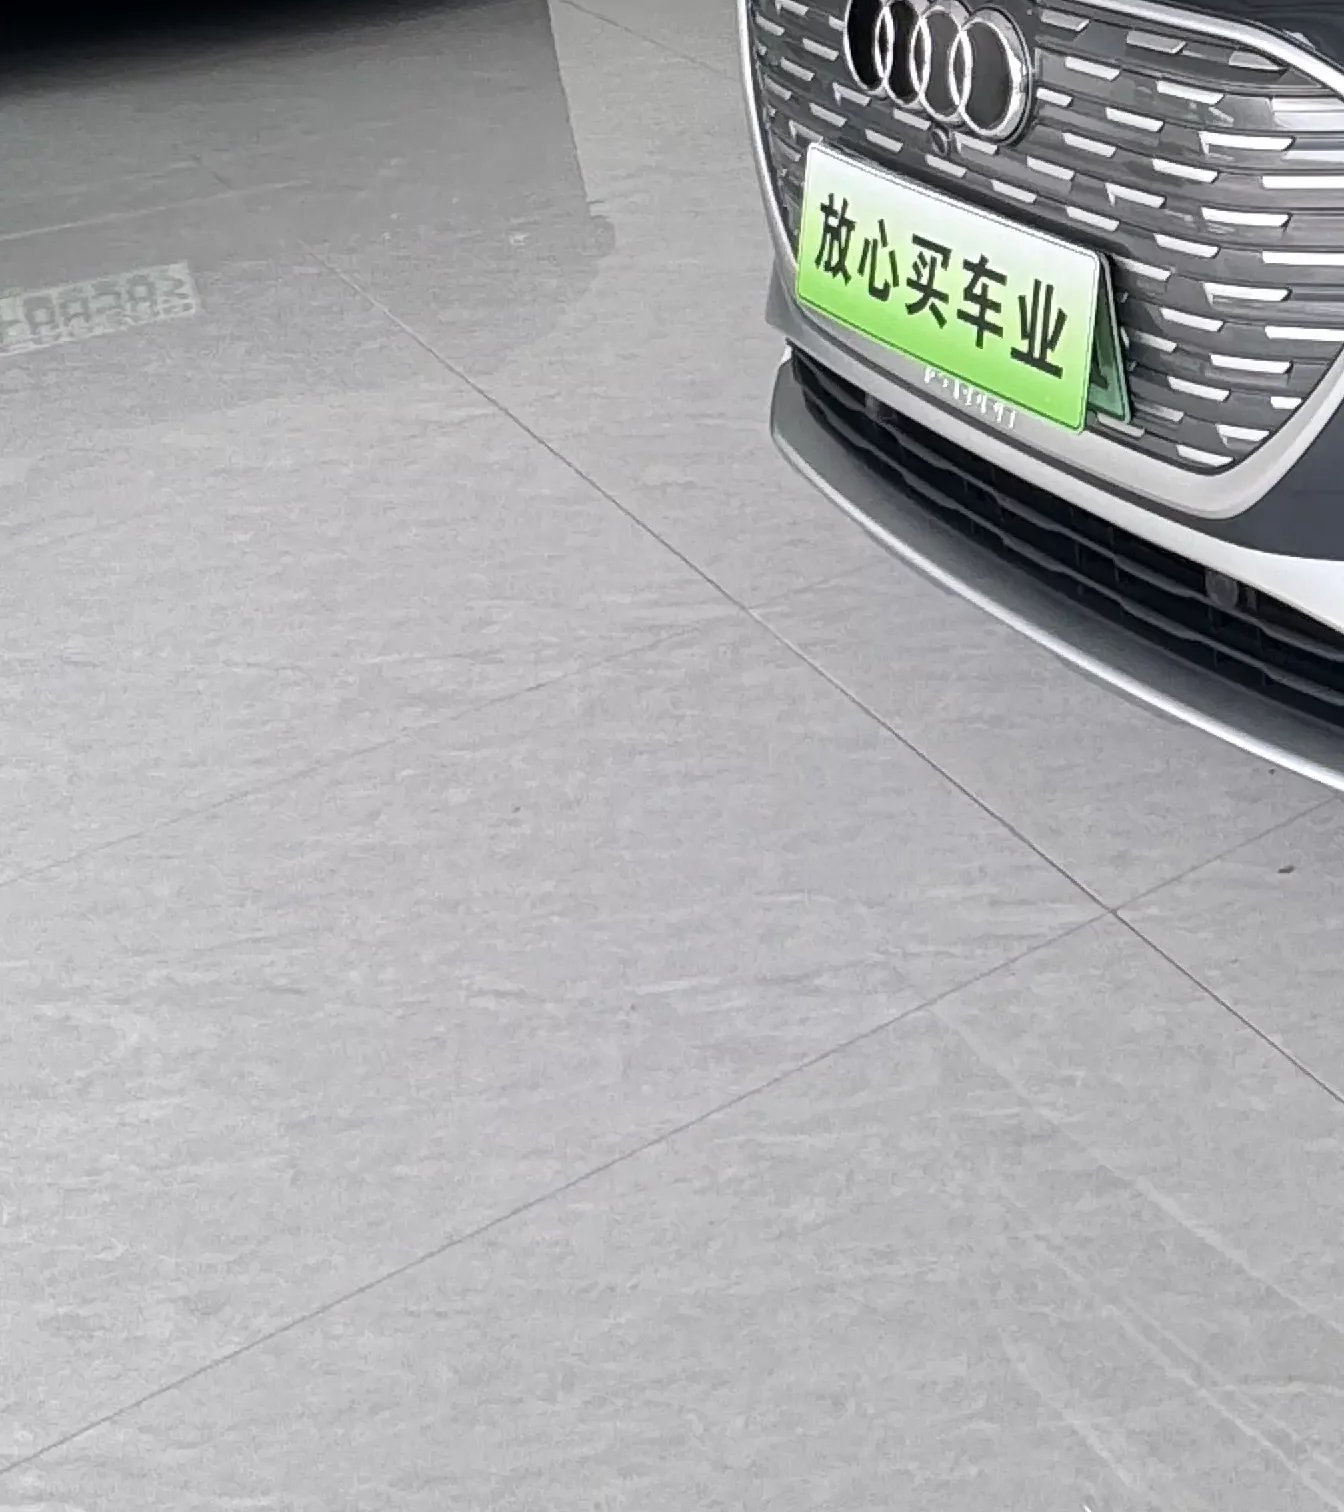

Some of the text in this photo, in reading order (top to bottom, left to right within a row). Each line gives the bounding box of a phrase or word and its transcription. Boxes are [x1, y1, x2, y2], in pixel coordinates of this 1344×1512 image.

[815, 192, 1068, 380] 放心买车业
